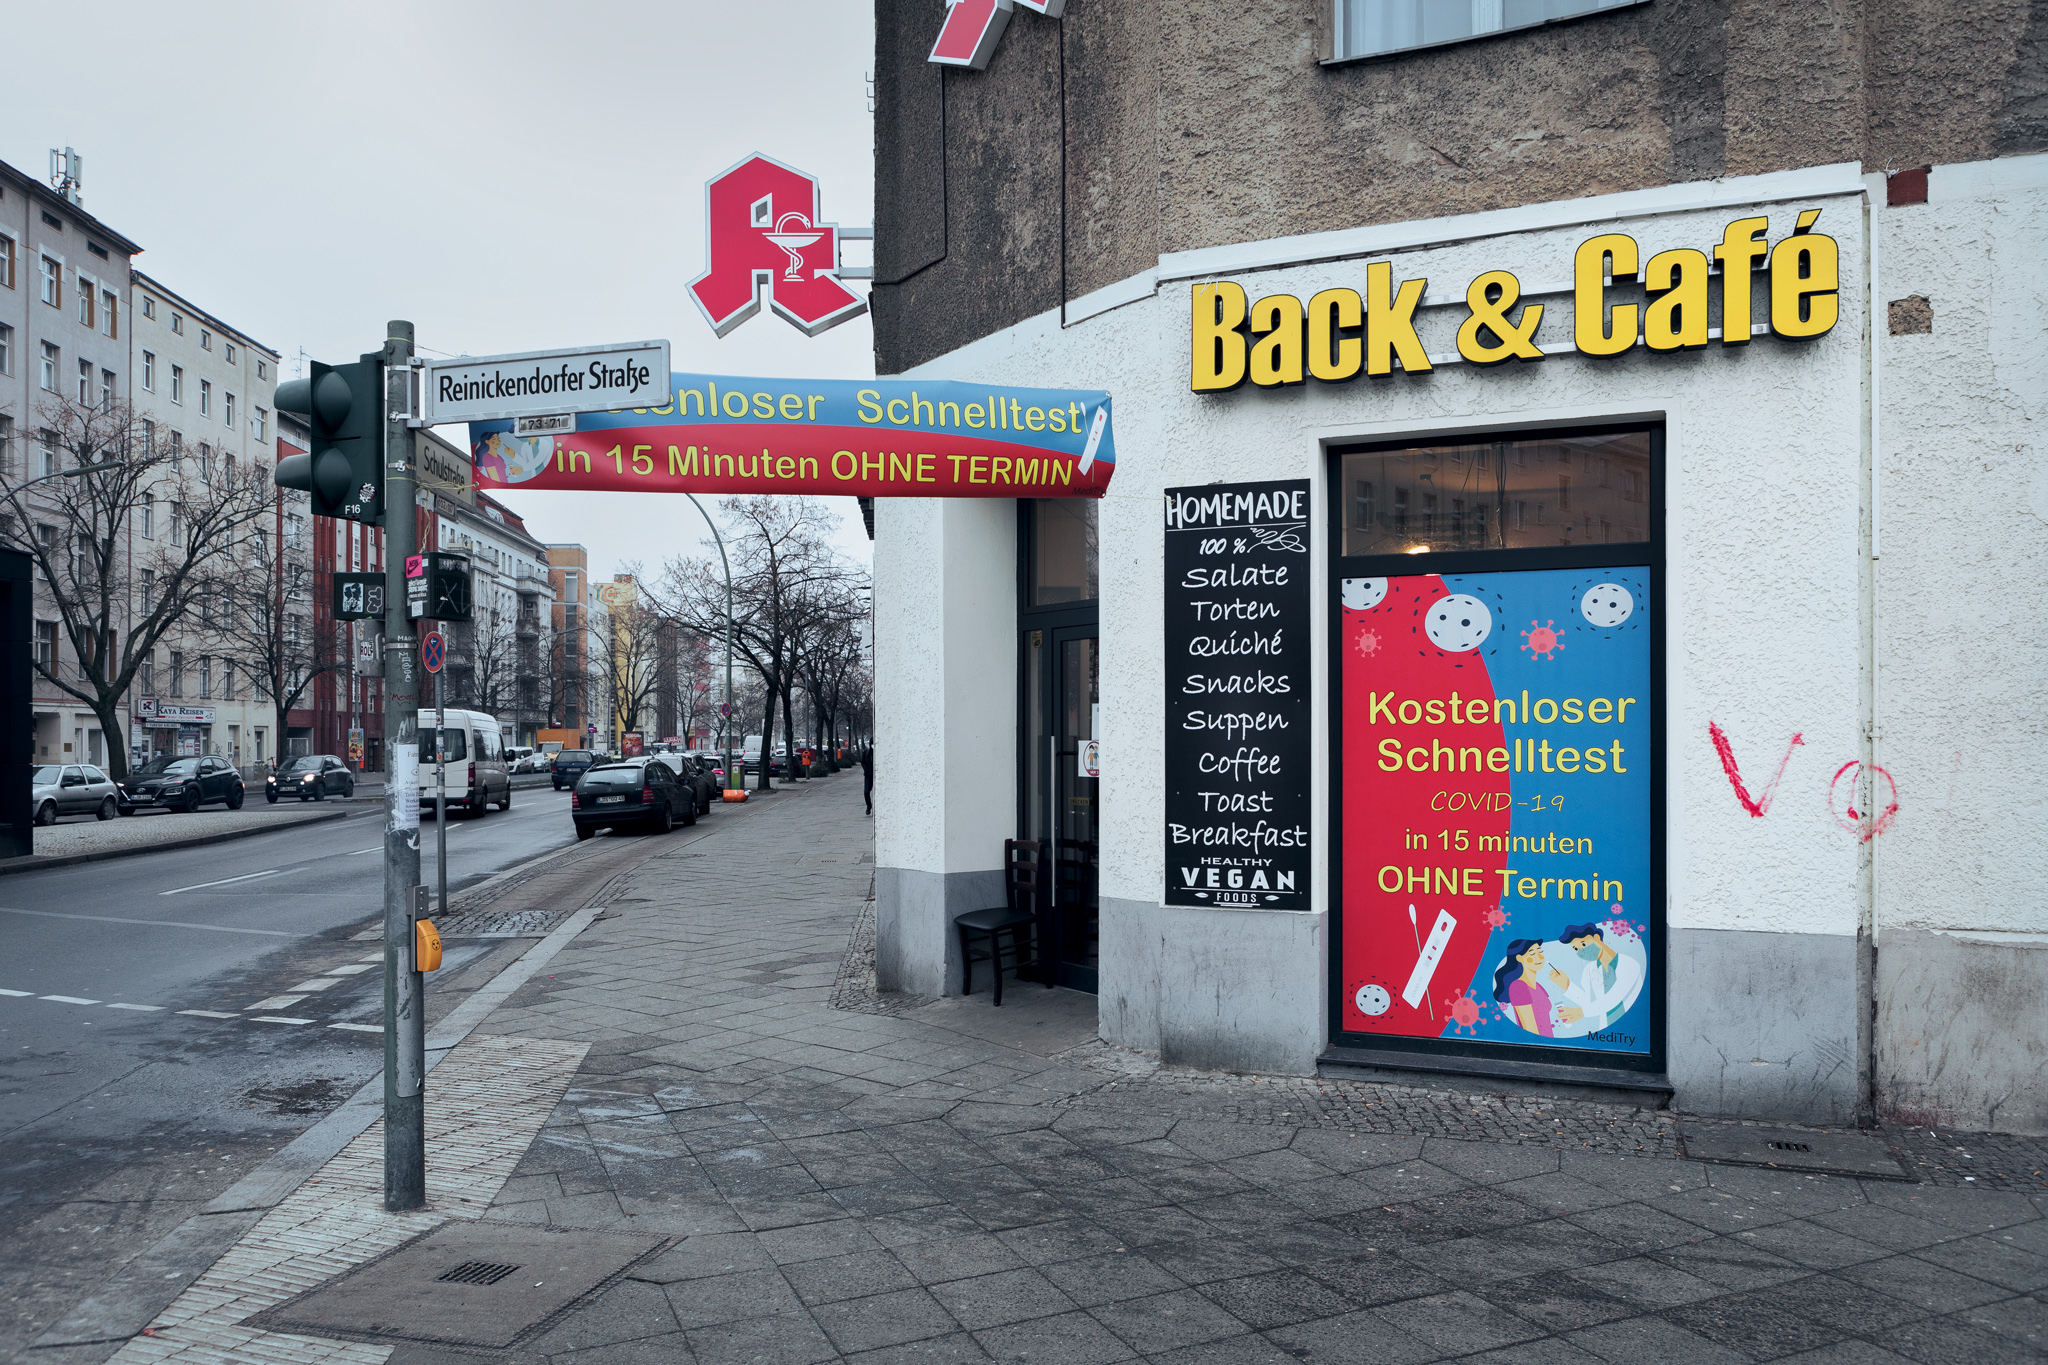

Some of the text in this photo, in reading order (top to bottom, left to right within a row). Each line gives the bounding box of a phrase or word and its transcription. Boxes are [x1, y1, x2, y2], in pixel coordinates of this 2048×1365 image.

[1191, 208, 1840, 395] Back & Café
[439, 358, 650, 403] Reinickendorfer Straße
[856, 389, 1083, 434] Schnelltest
[423, 445, 465, 496] Schulstraße
[556, 441, 1073, 486] in 15 Minuten OHNE TERMIN
[345, 504, 361, 515] F16
[1165, 491, 1307, 529] HOMEMADE
[1199, 538, 1248, 556] 100 %
[1181, 563, 1289, 588] Salate
[1190, 598, 1280, 621] Torten
[1182, 669, 1291, 695] Snacks
[1368, 689, 1638, 726] Kostenloser
[1182, 710, 1289, 741] Suppen
[1199, 747, 1281, 782] Coffee
[1377, 737, 1628, 774] Schnelltest
[1198, 791, 1274, 812] Toast
[1168, 819, 1308, 855] Breakfast
[1404, 827, 1595, 855] in 15 minuten
[1201, 857, 1273, 867] HEALTHY
[1181, 866, 1295, 891] VEGAN
[1377, 864, 1625, 903] OHNE Termin
[1216, 892, 1257, 903] FOODS
[1587, 1030, 1637, 1048] MediTry
